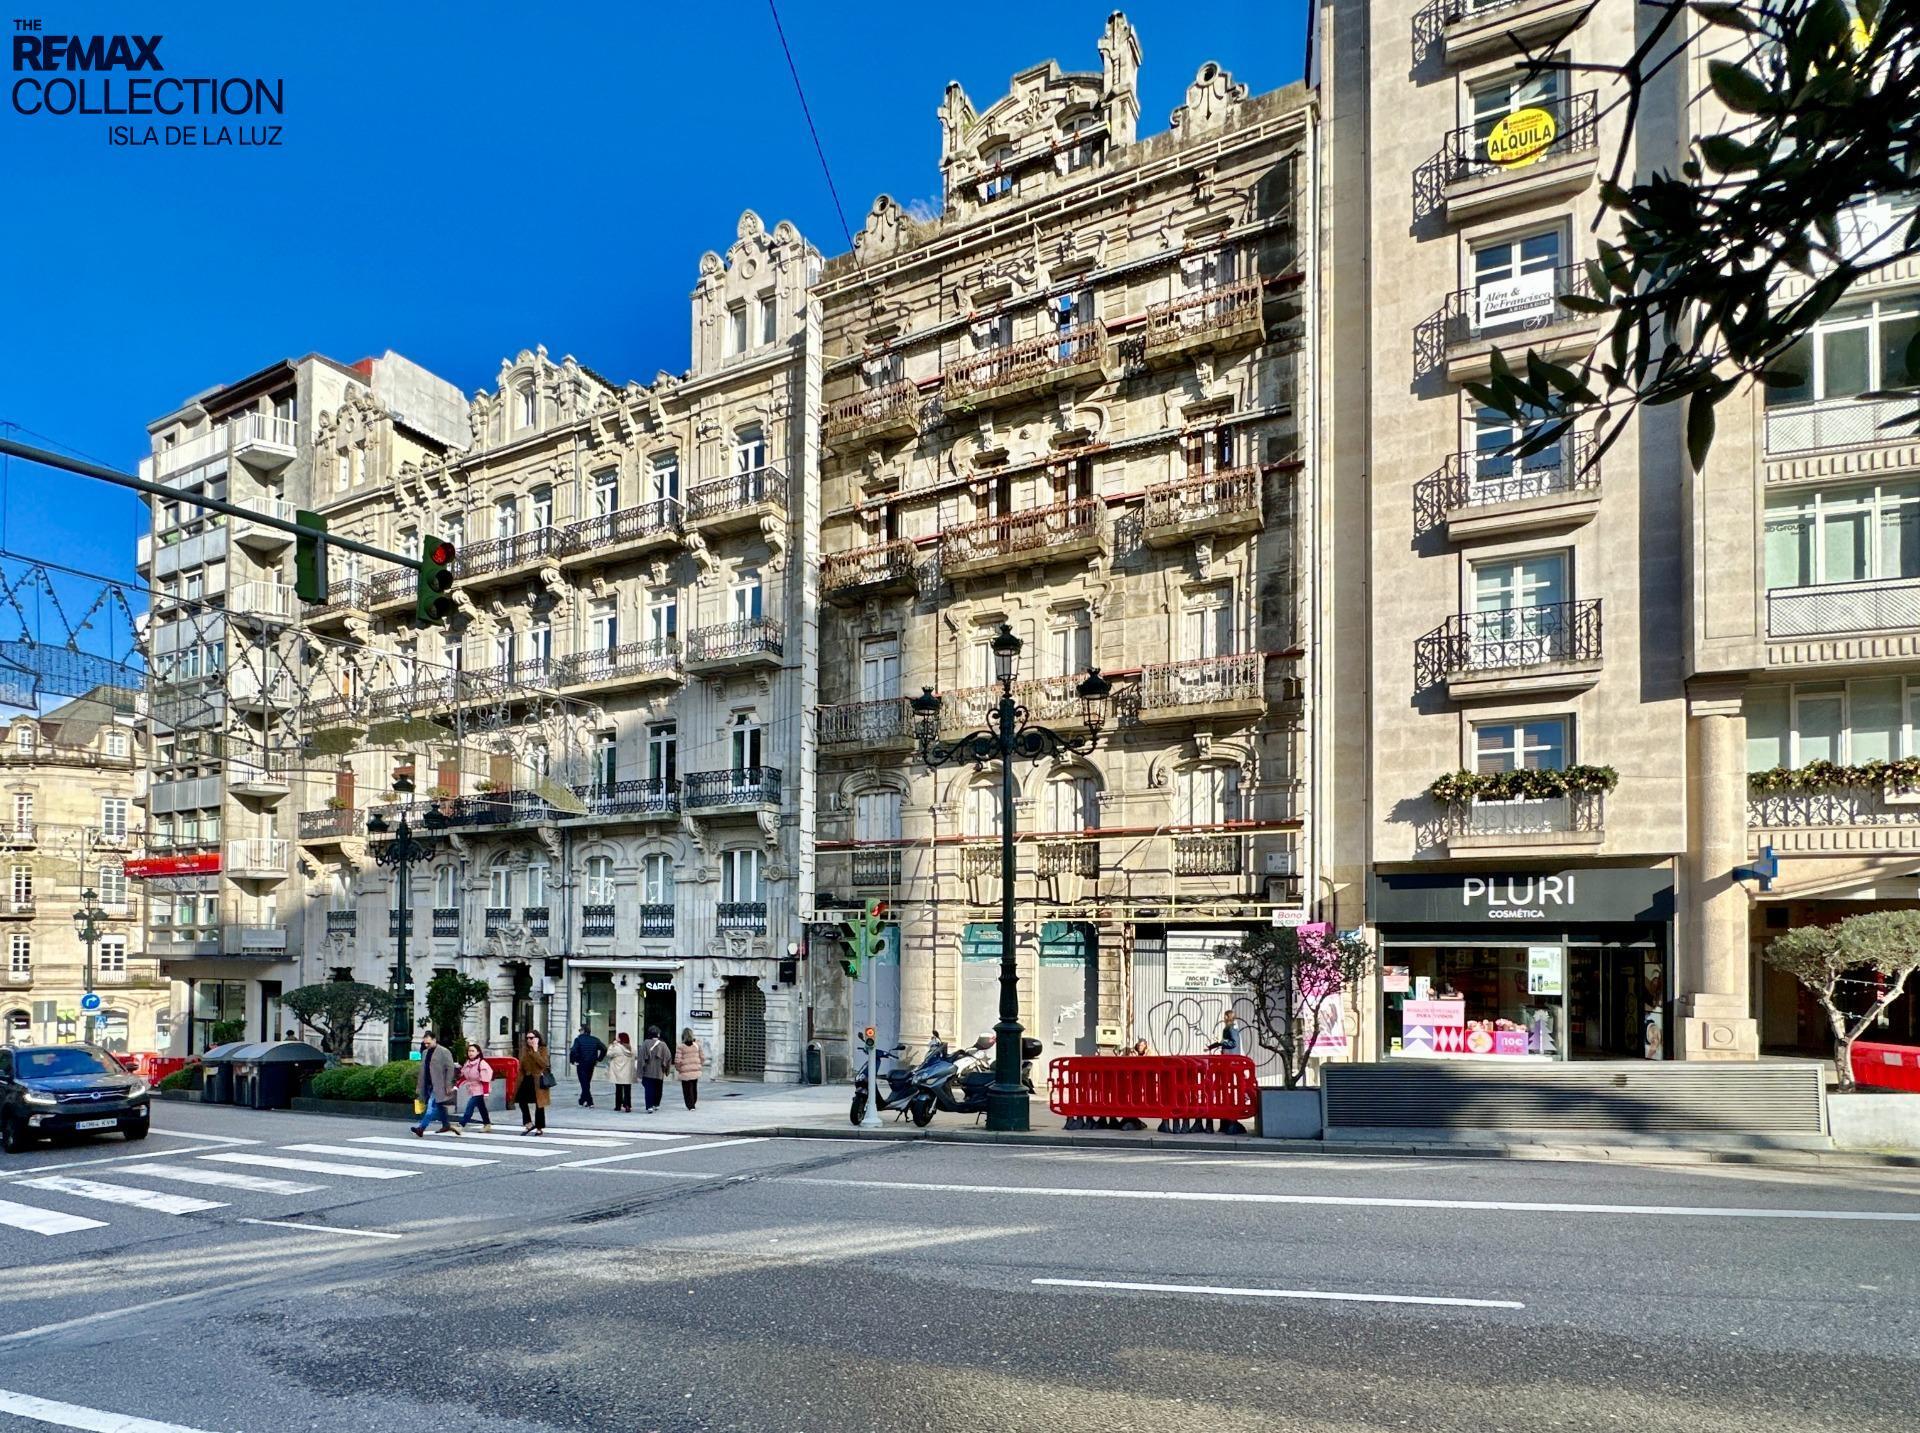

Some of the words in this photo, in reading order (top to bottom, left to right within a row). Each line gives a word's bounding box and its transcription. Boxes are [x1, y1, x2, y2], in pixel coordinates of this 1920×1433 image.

[1491, 125, 1552, 155] ALQUILA
[1511, 287, 1520, 296] &
[1776, 523, 1806, 532] Group
[1463, 875, 1575, 906] PLURI
[1278, 911, 1302, 920] Bono
[1488, 908, 1545, 919] COSMÉTICA
